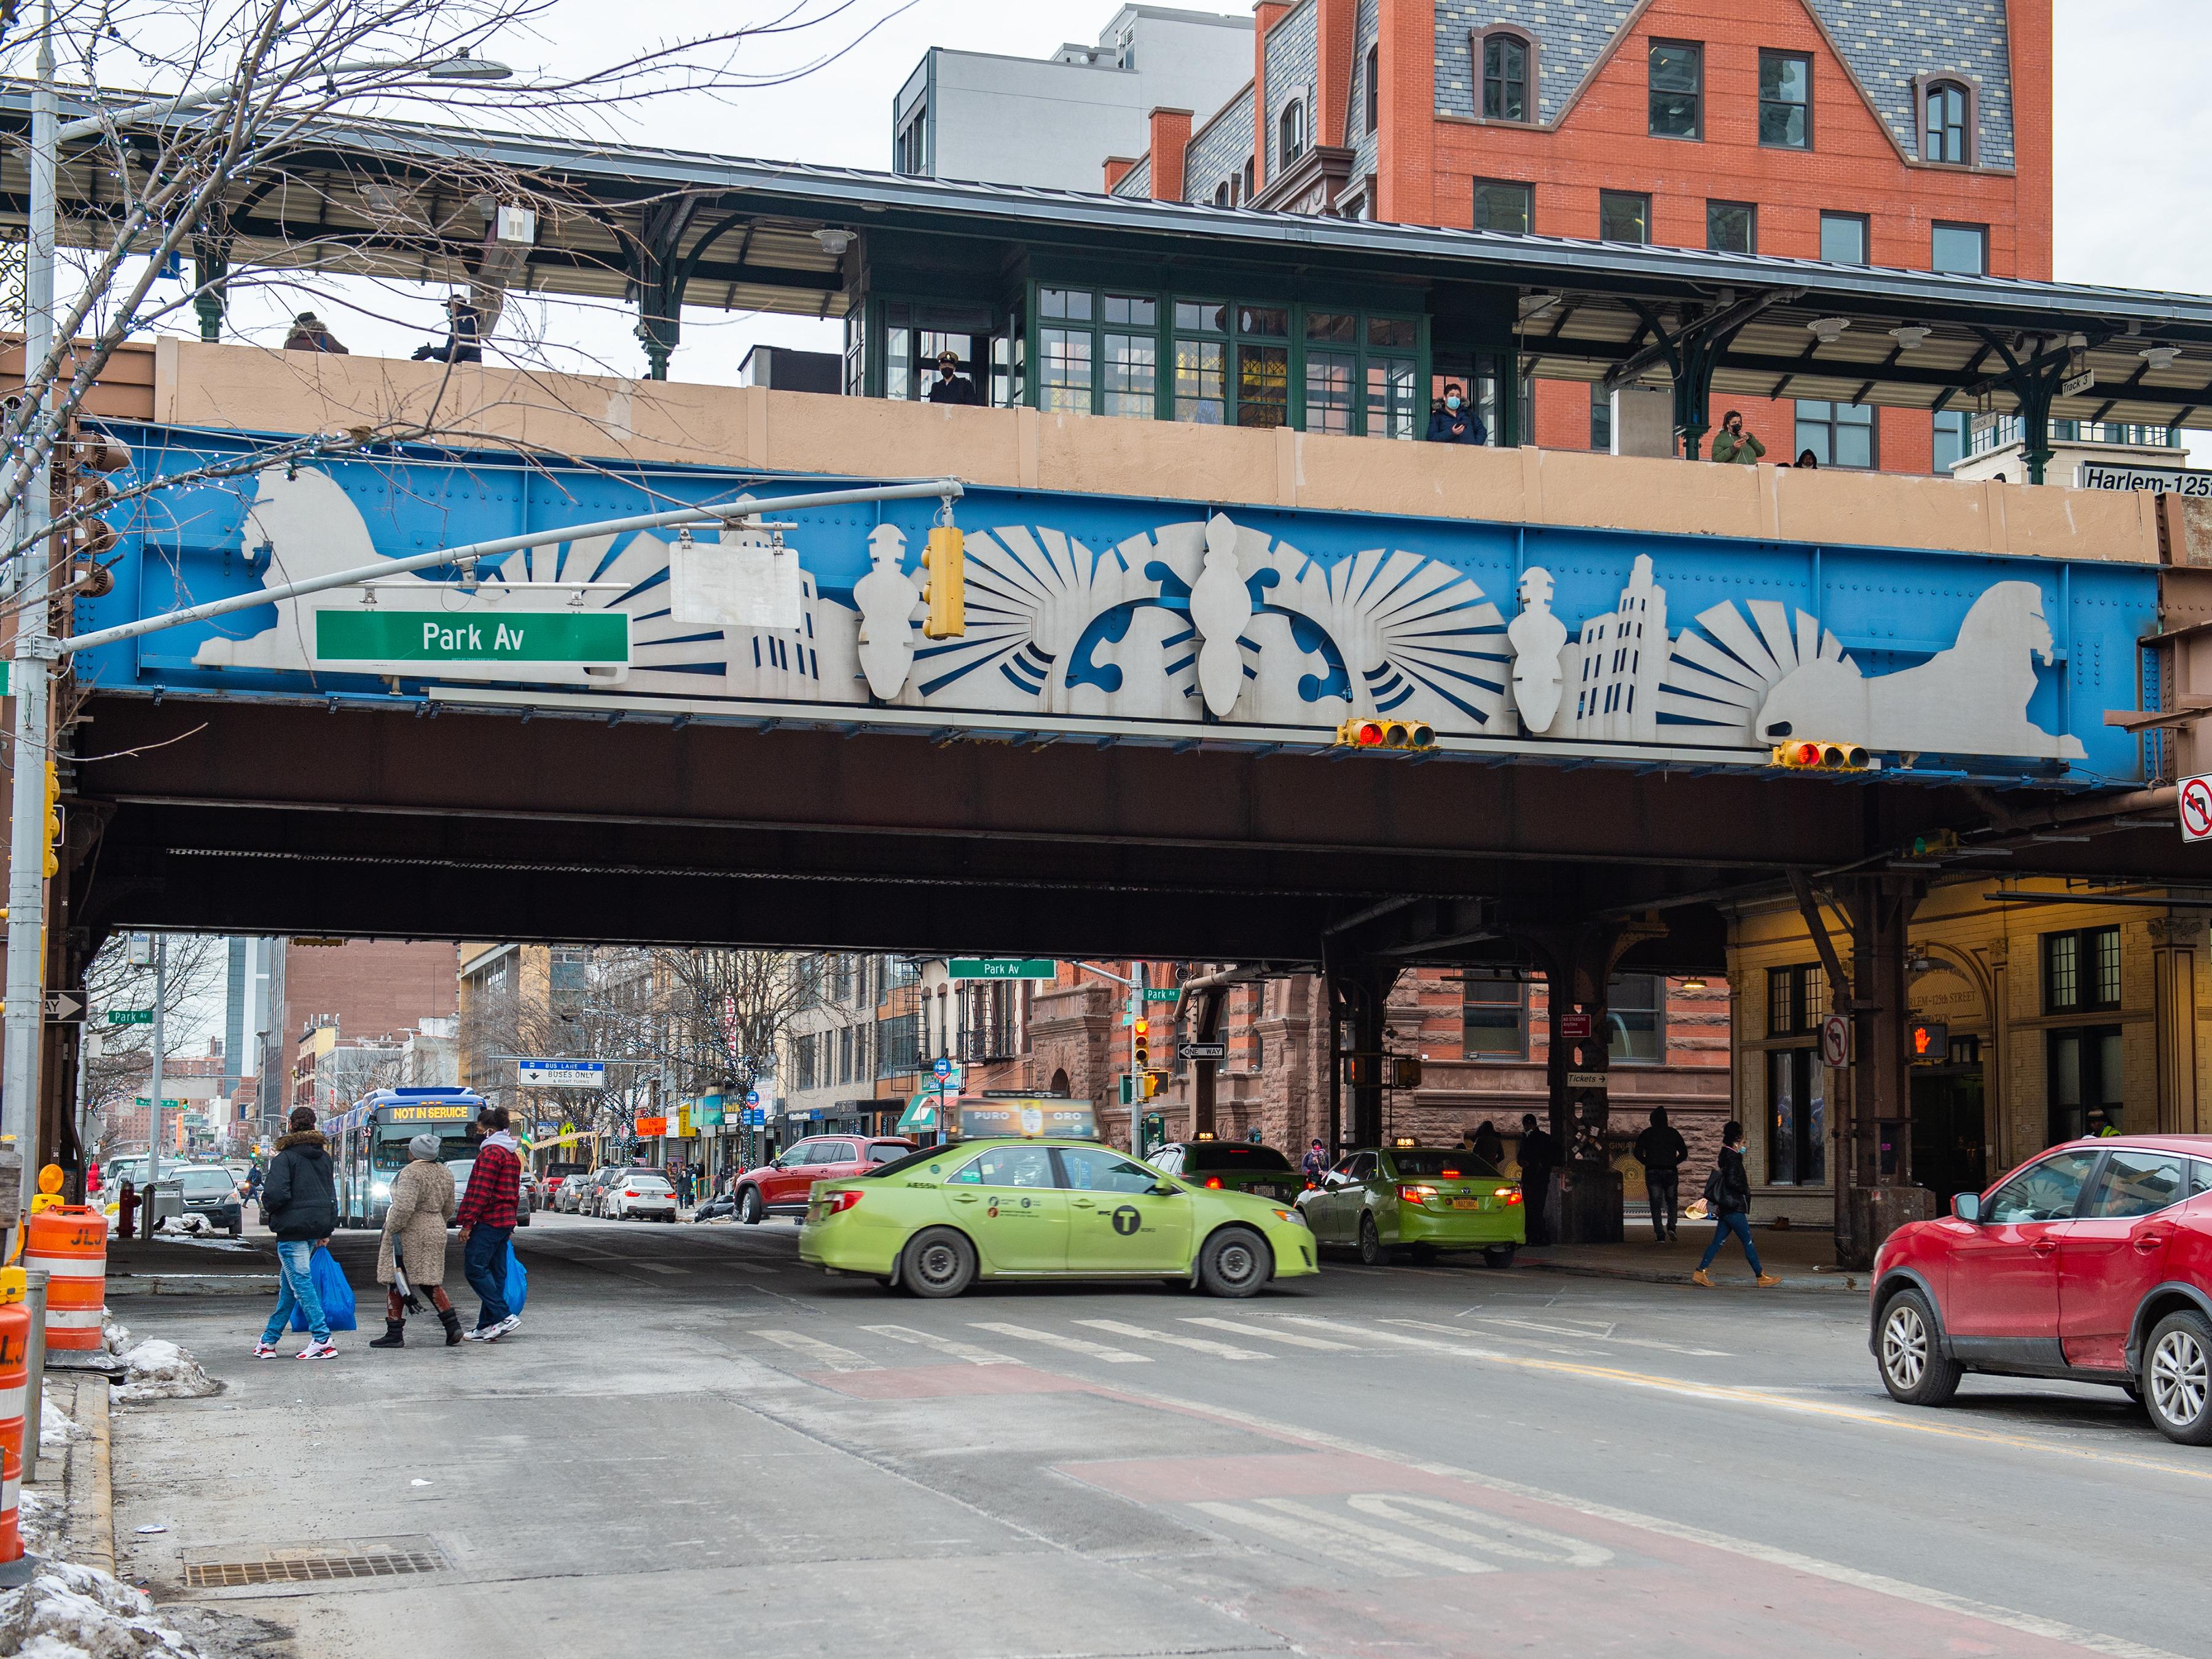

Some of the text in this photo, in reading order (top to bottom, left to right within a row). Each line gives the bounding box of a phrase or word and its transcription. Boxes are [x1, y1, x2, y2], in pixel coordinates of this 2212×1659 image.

[2063, 375, 2088, 393] Track 3
[1971, 418, 1987, 429] Track
[2087, 468, 2212, 496] Harlem-125
[423, 622, 524, 650] Park Av
[984, 963, 1019, 974] Park Av
[1148, 990, 1166, 999] Park
[1950, 991, 1975, 1003] STREET
[45, 999, 60, 1012] AY
[115, 1012, 136, 1022] Park
[394, 1107, 468, 1120] NOT IN SERVICE
[974, 1112, 1082, 1120] PURO ORO
[1117, 1211, 1136, 1232] T
[70, 1228, 102, 1245] JLJ
[0, 1335, 27, 1365] LJ
